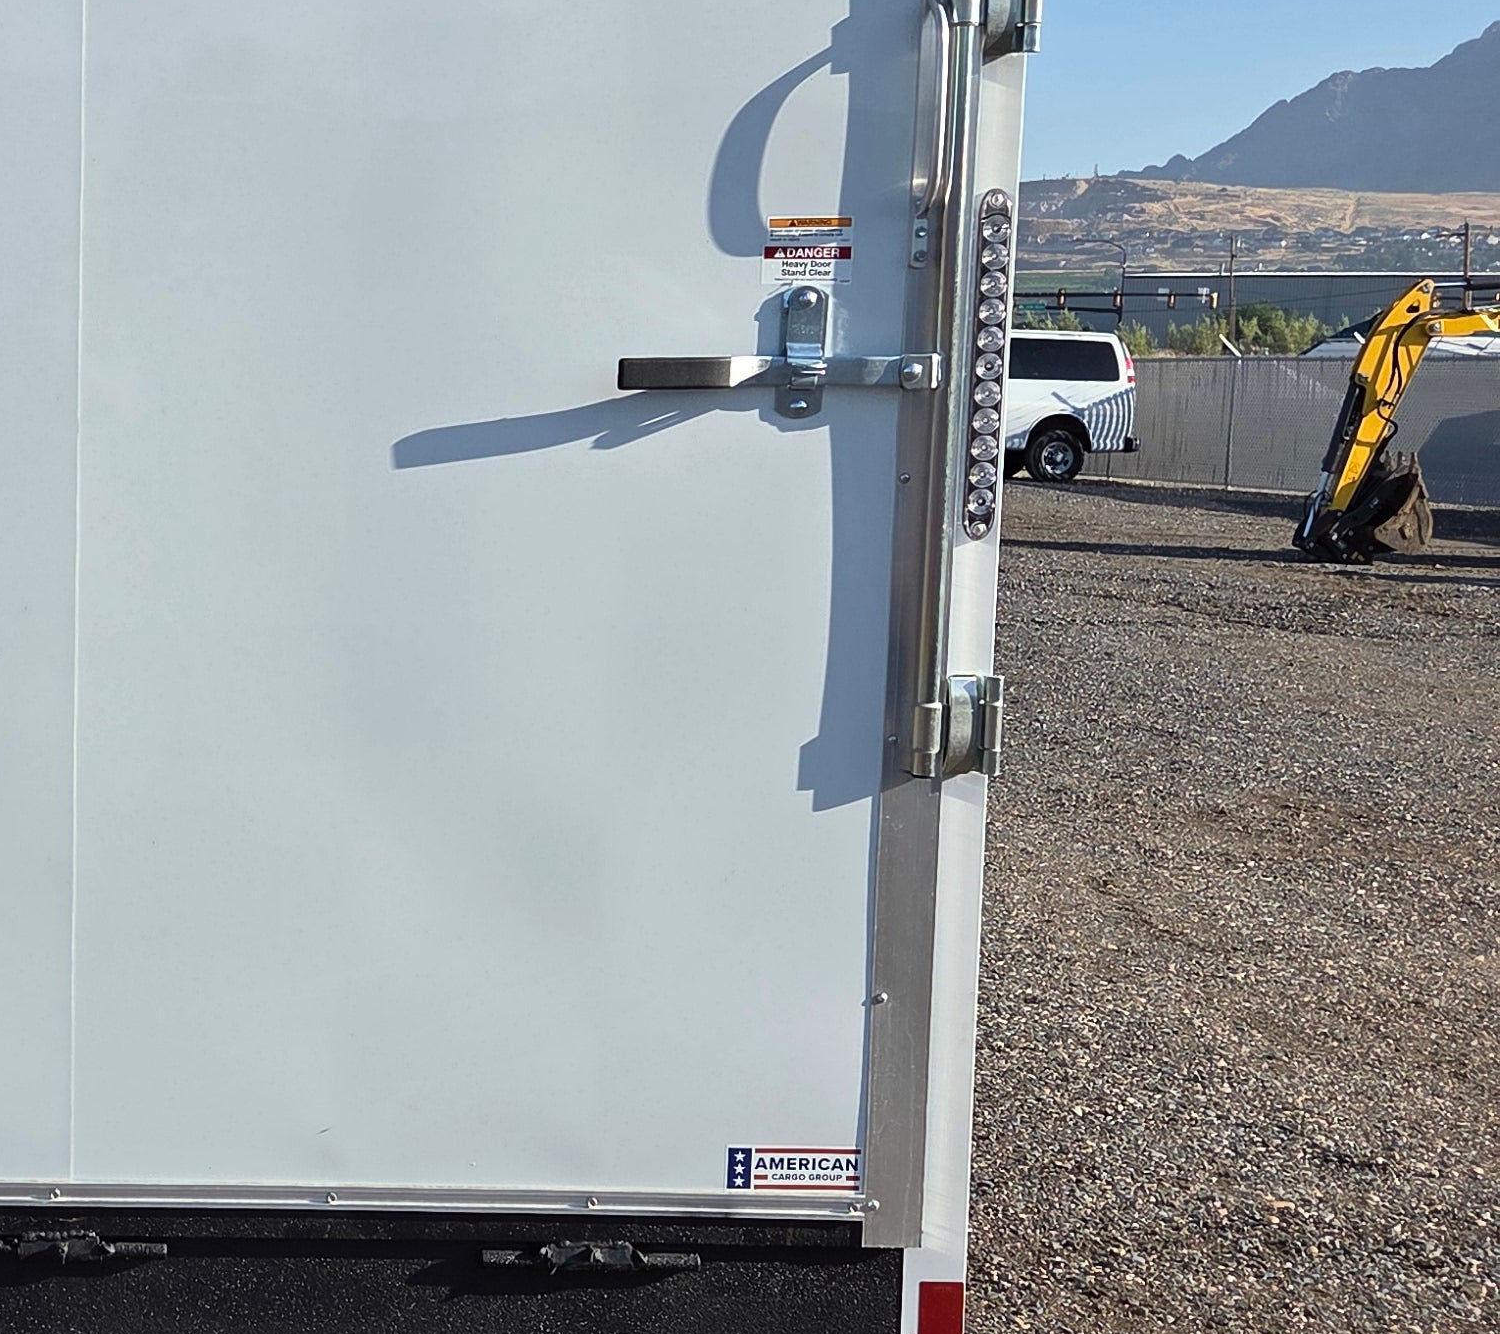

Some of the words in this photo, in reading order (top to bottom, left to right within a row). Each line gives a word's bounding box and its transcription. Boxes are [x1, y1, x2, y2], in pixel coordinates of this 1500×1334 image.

[786, 248, 840, 258] DANGER
[781, 260, 809, 269] Heavy
[810, 260, 832, 268] Door
[781, 269, 806, 277] Stand
[808, 269, 832, 277] Clear
[754, 1157, 859, 1172] AMERICAN
[771, 1173, 806, 1181] CARGO
[808, 1173, 843, 1182] GROUP
